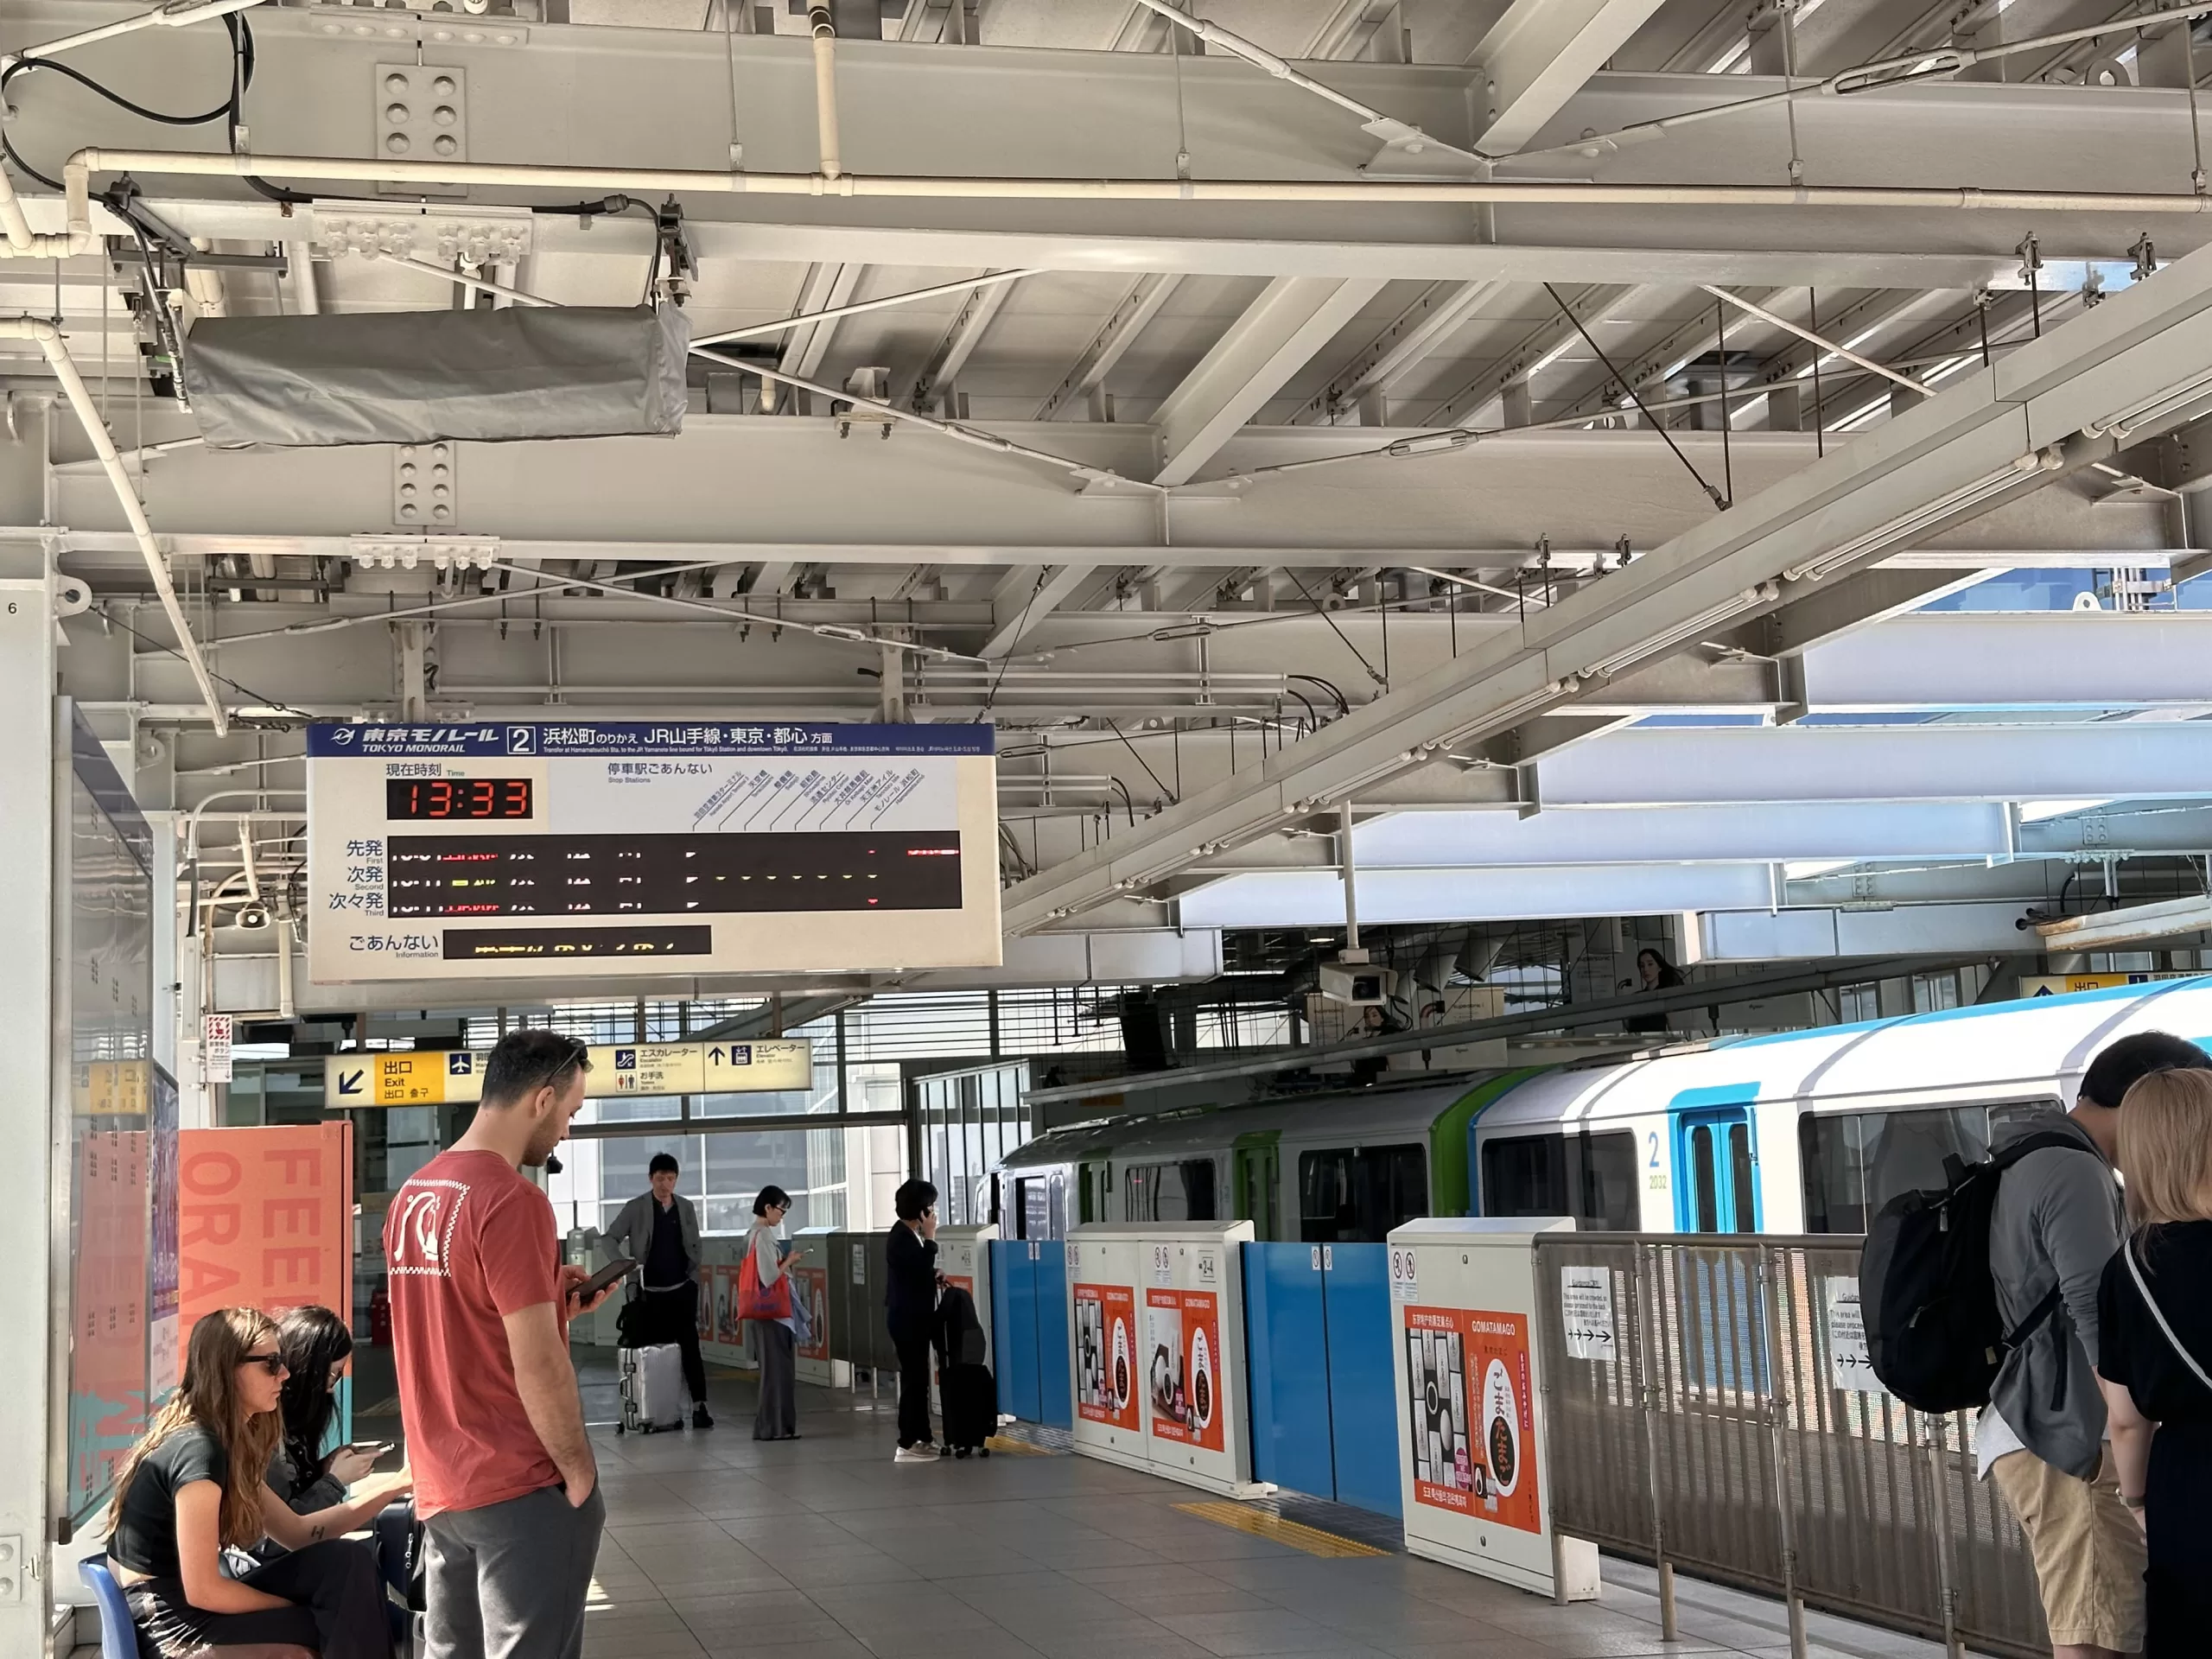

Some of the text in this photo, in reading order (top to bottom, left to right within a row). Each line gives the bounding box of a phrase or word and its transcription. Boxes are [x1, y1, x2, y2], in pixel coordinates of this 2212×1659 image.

[9, 602, 17, 613] 6
[362, 728, 499, 742] 東京モノレール
[512, 728, 530, 752] 2
[543, 728, 638, 745] 浜松町のりかえ
[810, 733, 833, 744] 方面
[362, 744, 466, 753] TOKYO MONORAIL
[386, 763, 442, 776] 現在時刻
[608, 763, 713, 775] 停車駅ごあんない
[410, 782, 527, 816] 13:33
[346, 840, 383, 856] 先発
[346, 866, 383, 882] 次発
[329, 893, 384, 909] 次々発
[350, 935, 439, 950] ごあんない
[640, 1048, 697, 1057] エスカレーター
[756, 1044, 805, 1053] エレベーター
[384, 1061, 412, 1075] 出口
[385, 1078, 404, 1087] Exit
[385, 1090, 404, 1099] 出口
[1649, 1131, 1660, 1167] 2
[1649, 1175, 1667, 1189] 2032
[181, 1151, 243, 1326] ORA
[1471, 1320, 1516, 1336] GOMATAMAGO
